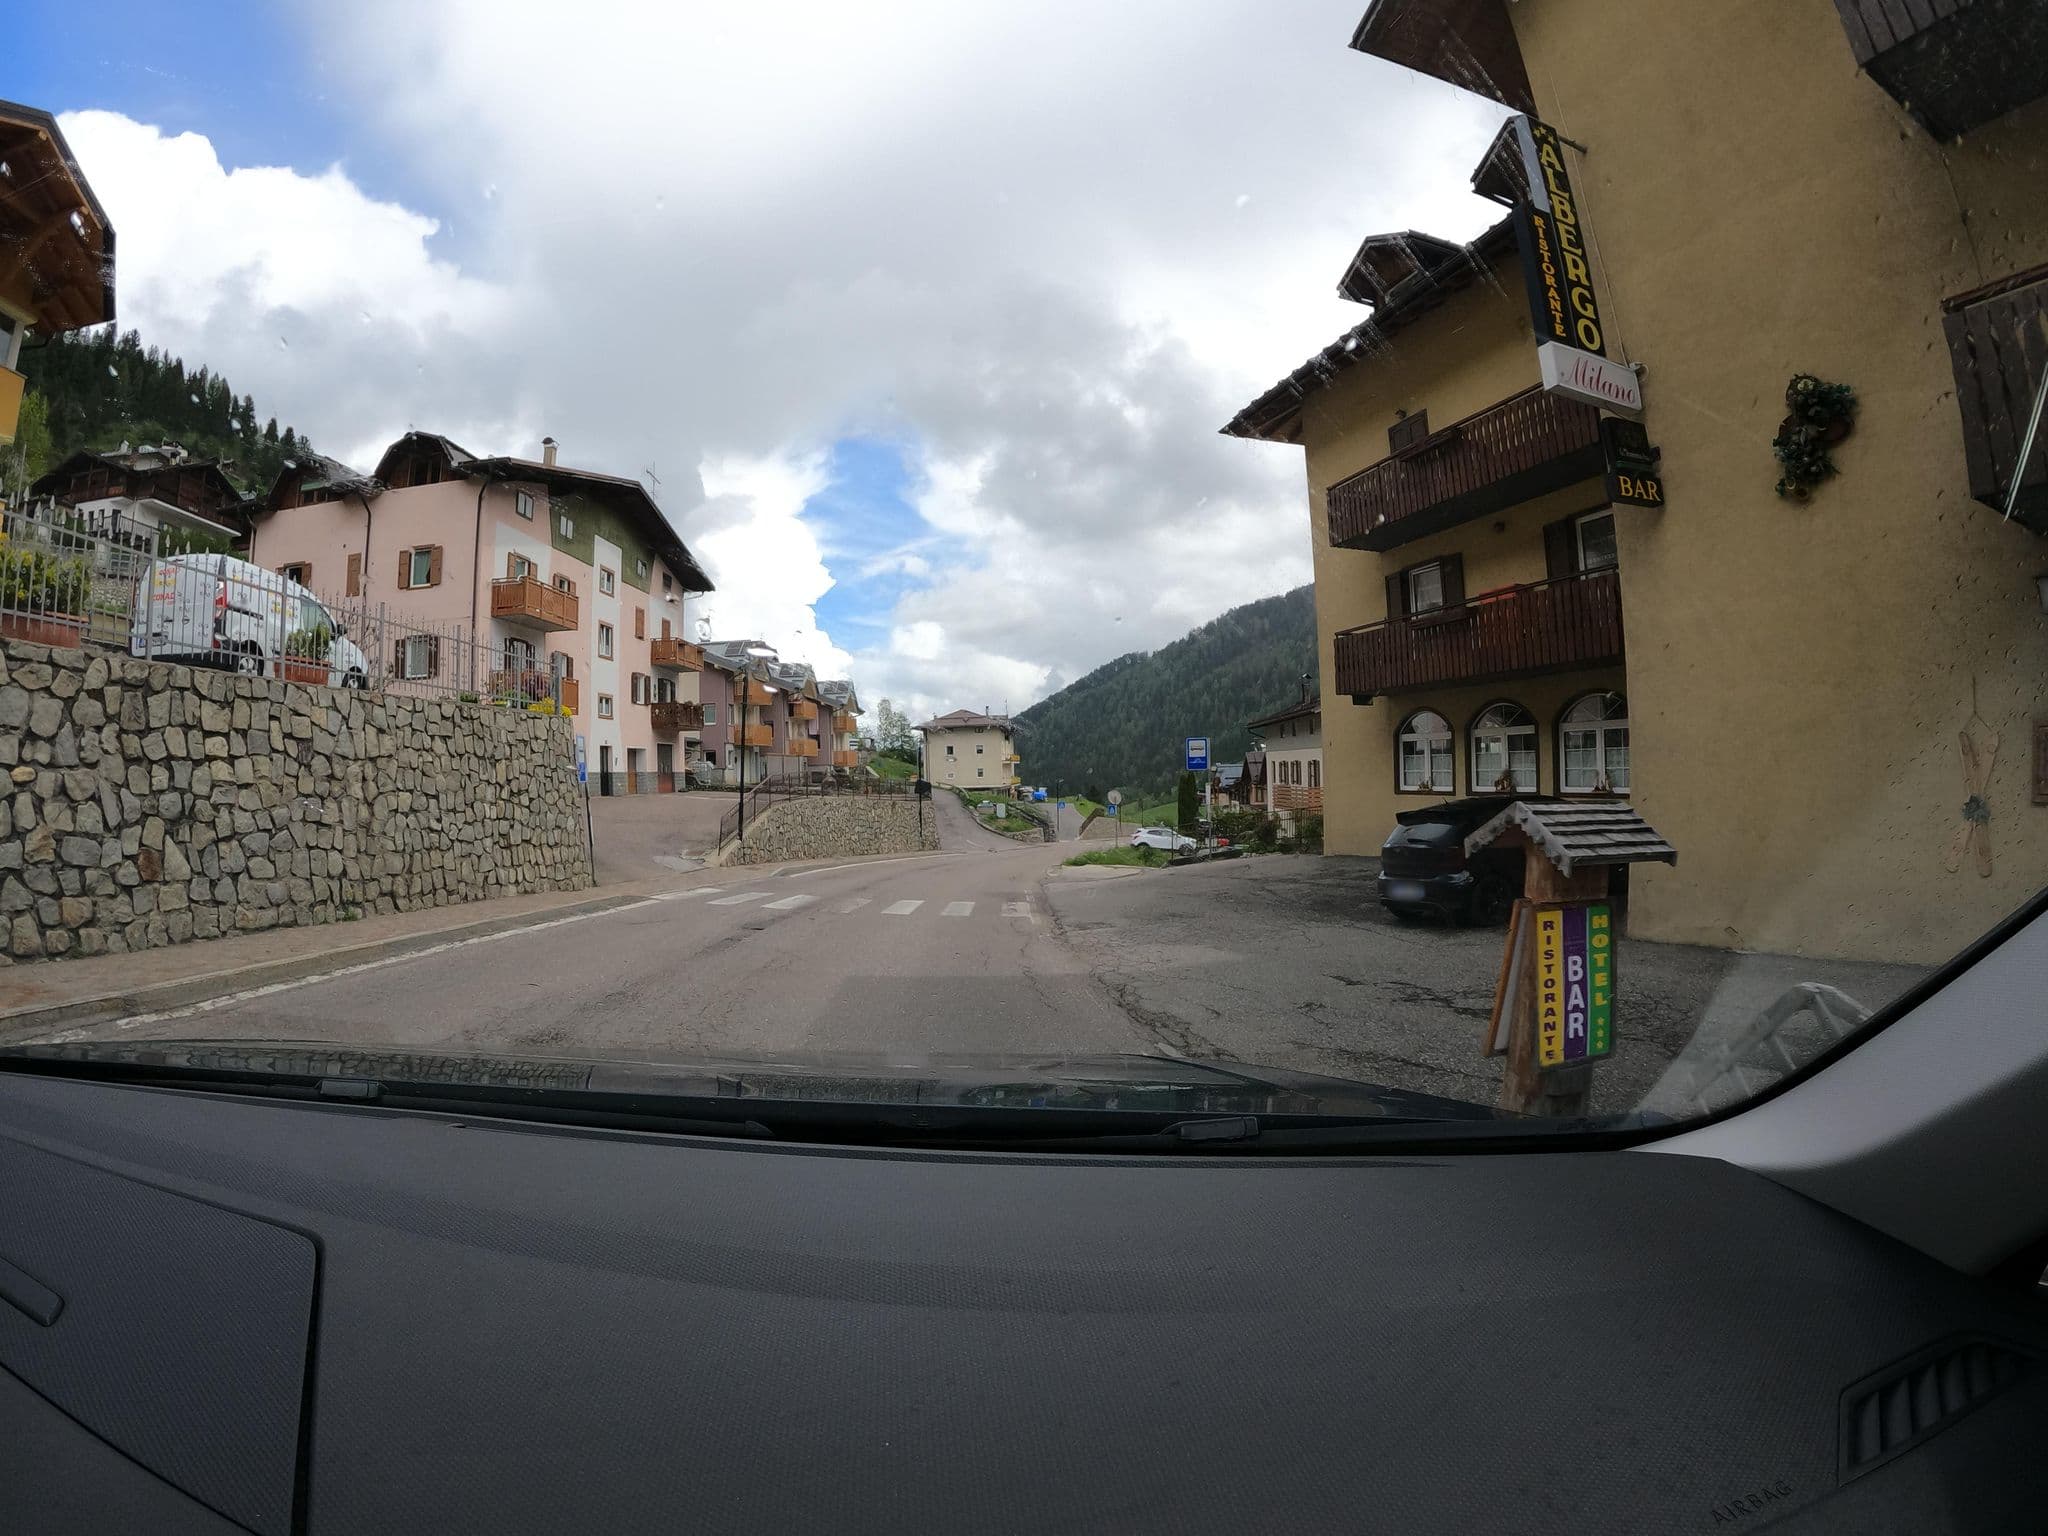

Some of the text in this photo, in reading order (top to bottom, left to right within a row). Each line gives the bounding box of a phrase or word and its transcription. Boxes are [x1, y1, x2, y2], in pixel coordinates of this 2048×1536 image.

[1533, 215, 1566, 337] RISTORANTE
[1541, 144, 1601, 351] ALBERGO
[1566, 357, 1636, 403] Milano
[1618, 475, 1661, 501] BAR
[1542, 920, 1557, 1060] RISTORANTE
[1567, 955, 1585, 1039] BAR
[1592, 915, 1609, 1006] HOTEL
[1711, 1480, 1792, 1525] AIRBAG
